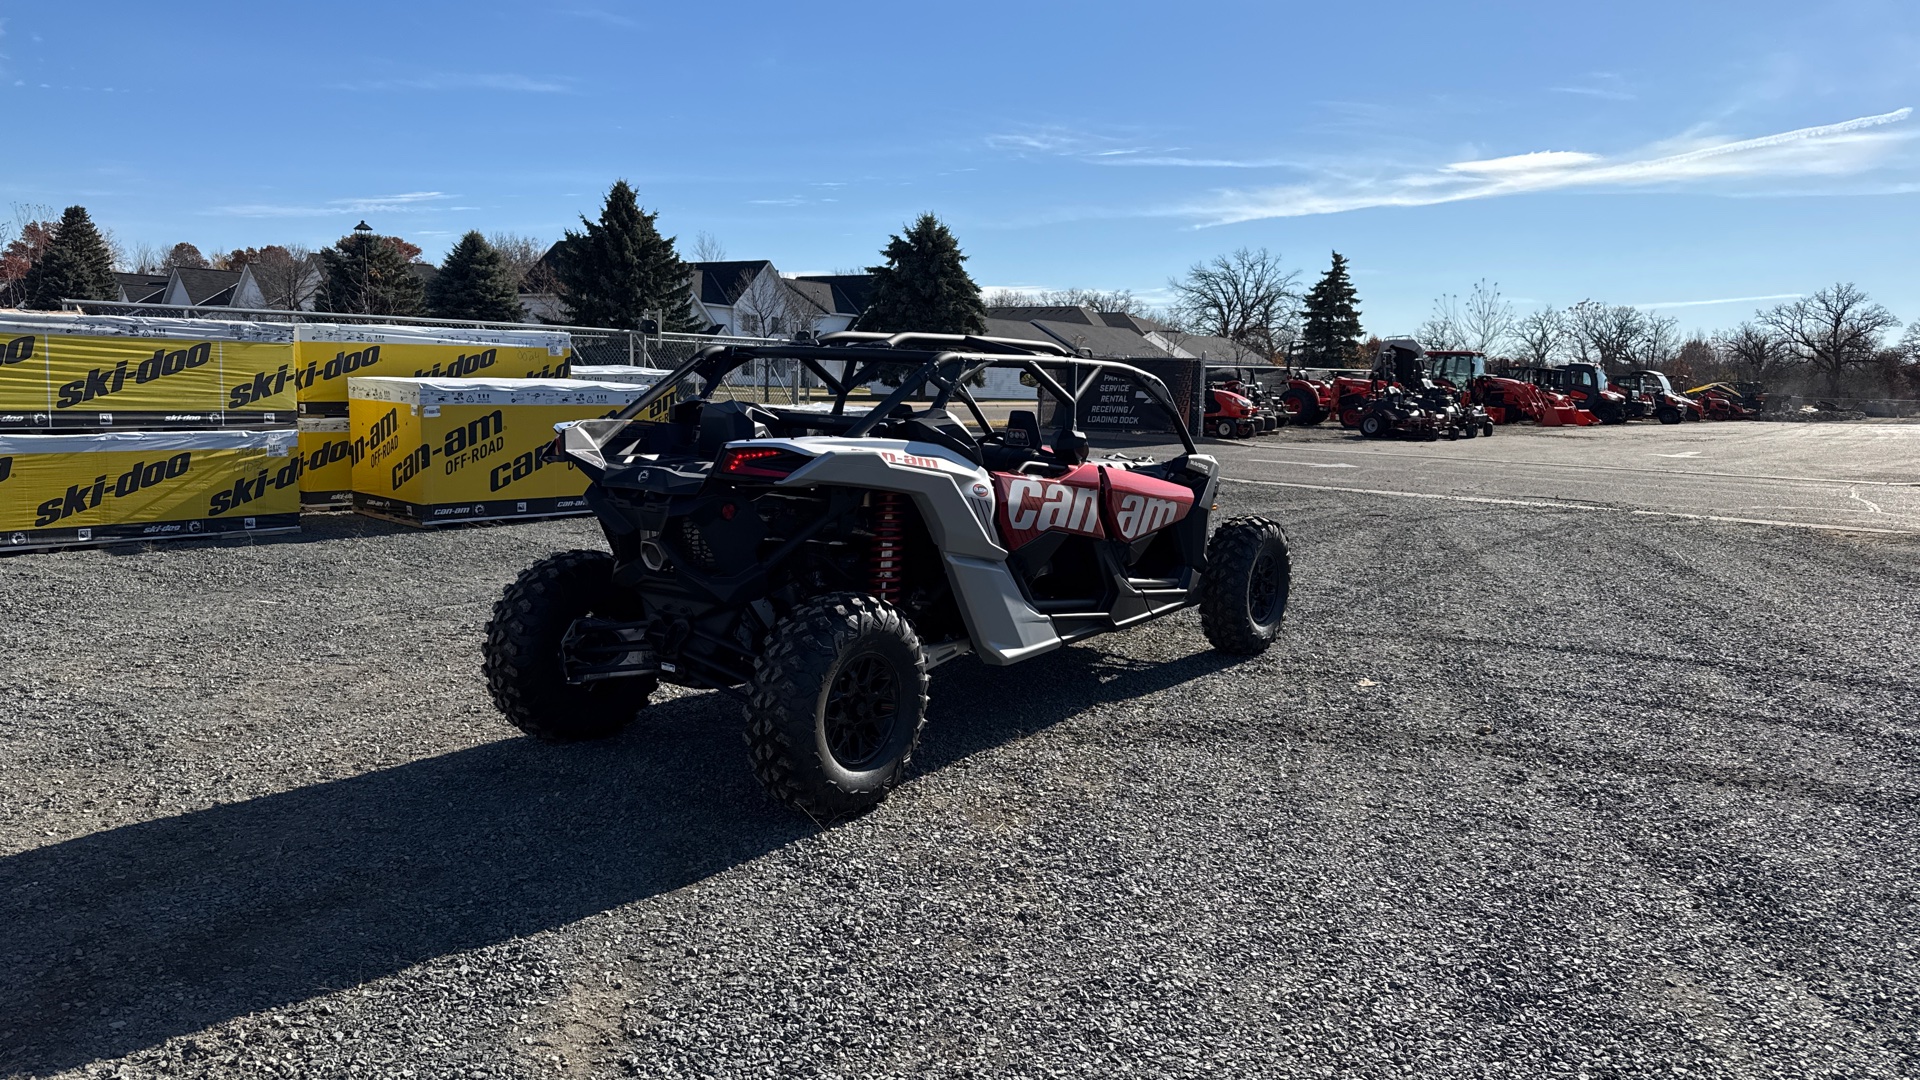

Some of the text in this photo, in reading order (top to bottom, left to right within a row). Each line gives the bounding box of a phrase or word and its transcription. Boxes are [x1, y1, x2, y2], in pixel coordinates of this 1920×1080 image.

[56, 342, 212, 409] ski-doo
[1103, 374, 1126, 382] PAR
[1100, 384, 1130, 392] SERVICE
[1100, 395, 1128, 403] RENTAL
[1091, 405, 1129, 413] RECEIVING
[164, 414, 201, 422] ski-doo
[1087, 415, 1140, 424] LOADING DOCK
[370, 435, 399, 469] OFF-ROAD
[392, 410, 503, 491] can-am
[445, 436, 504, 476] OFF-ROAD
[34, 452, 191, 527] ski-doo
[434, 507, 470, 516] can-am
[1007, 479, 1178, 539] can am
[143, 524, 181, 534] ski-doo
